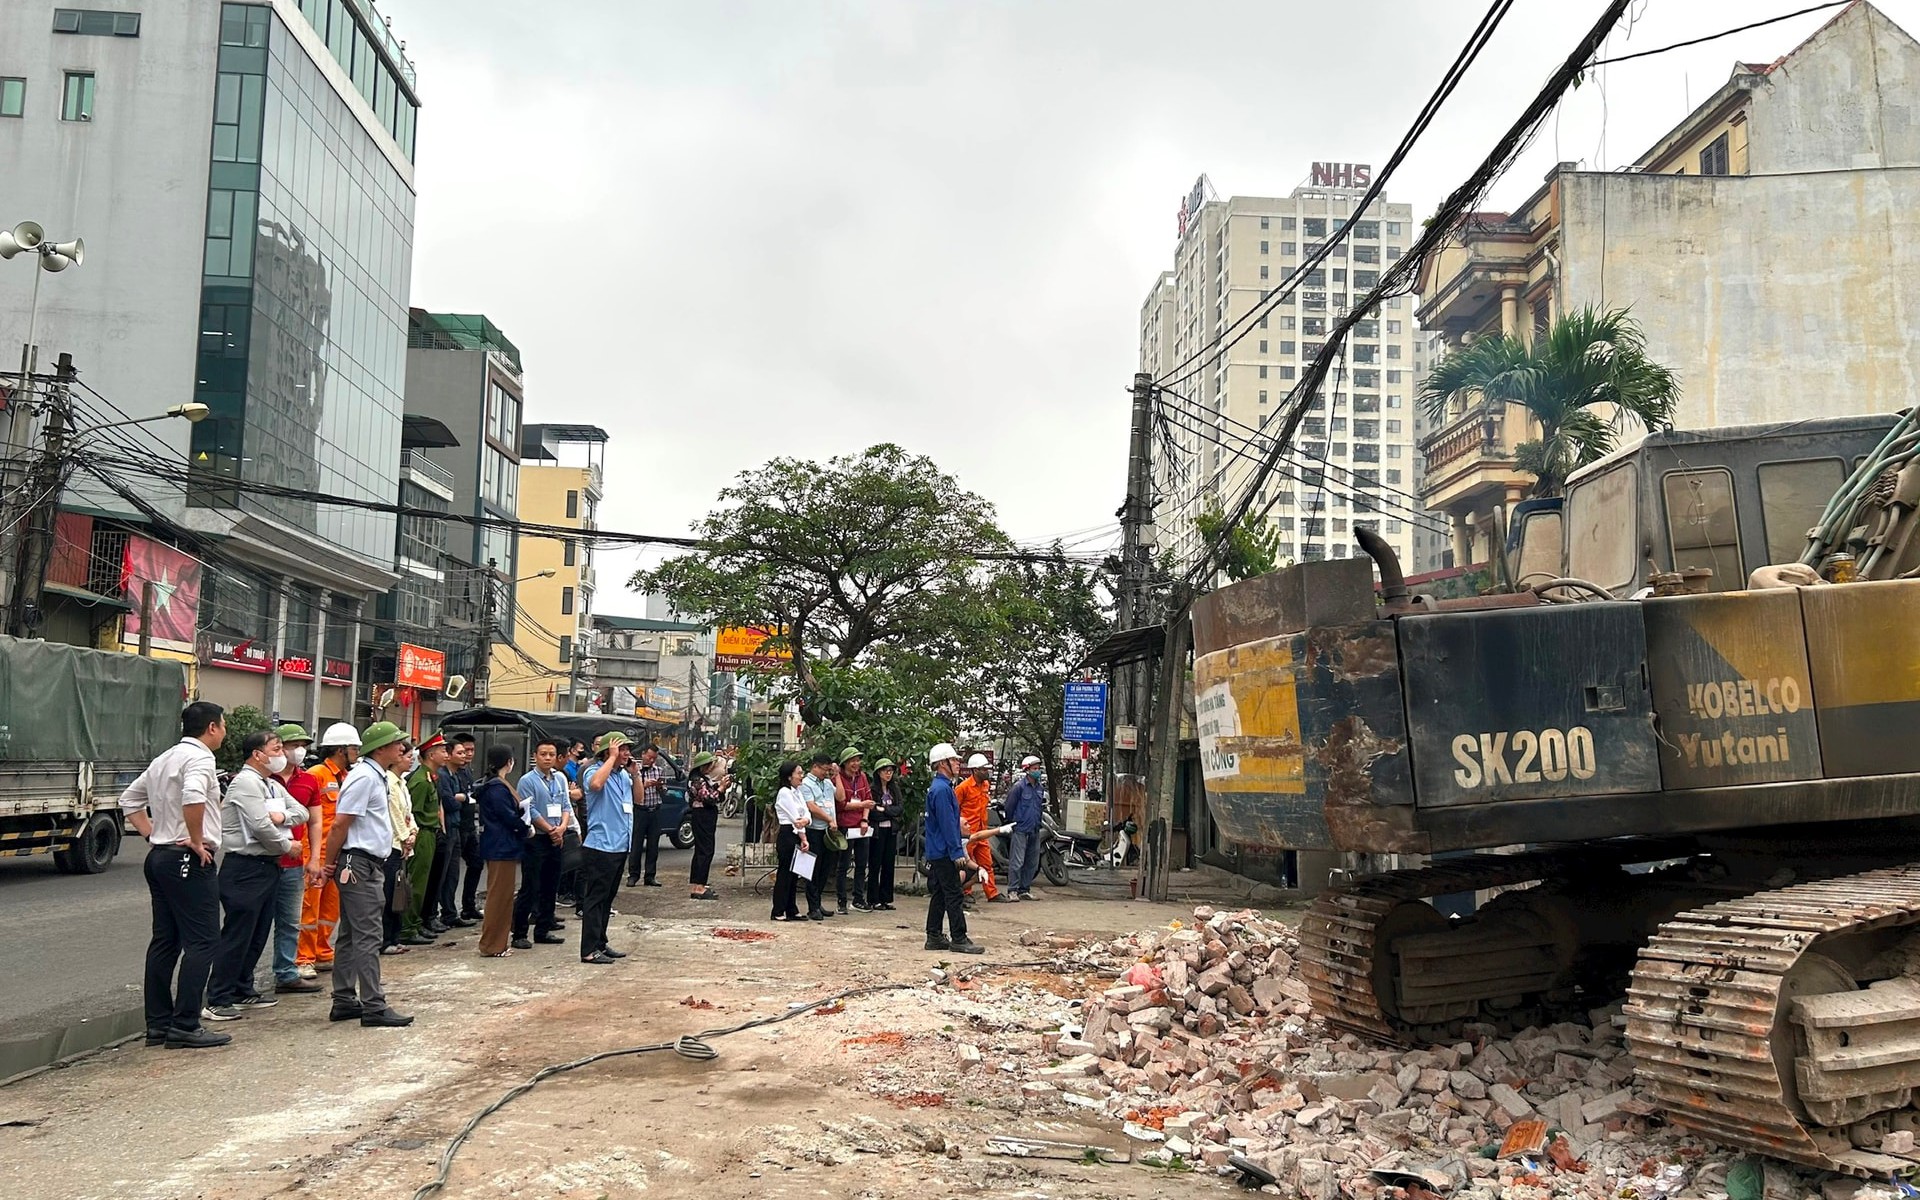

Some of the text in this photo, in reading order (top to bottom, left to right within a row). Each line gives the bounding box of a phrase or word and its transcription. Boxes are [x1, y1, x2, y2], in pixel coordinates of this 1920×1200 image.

[1312, 162, 1371, 188] NHS
[283, 659, 307, 673] GYM
[717, 654, 739, 664] Thẩm
[1687, 675, 1801, 720] KOBELCO
[1451, 726, 1597, 789] SK200
[1678, 727, 1790, 768] Yutani
